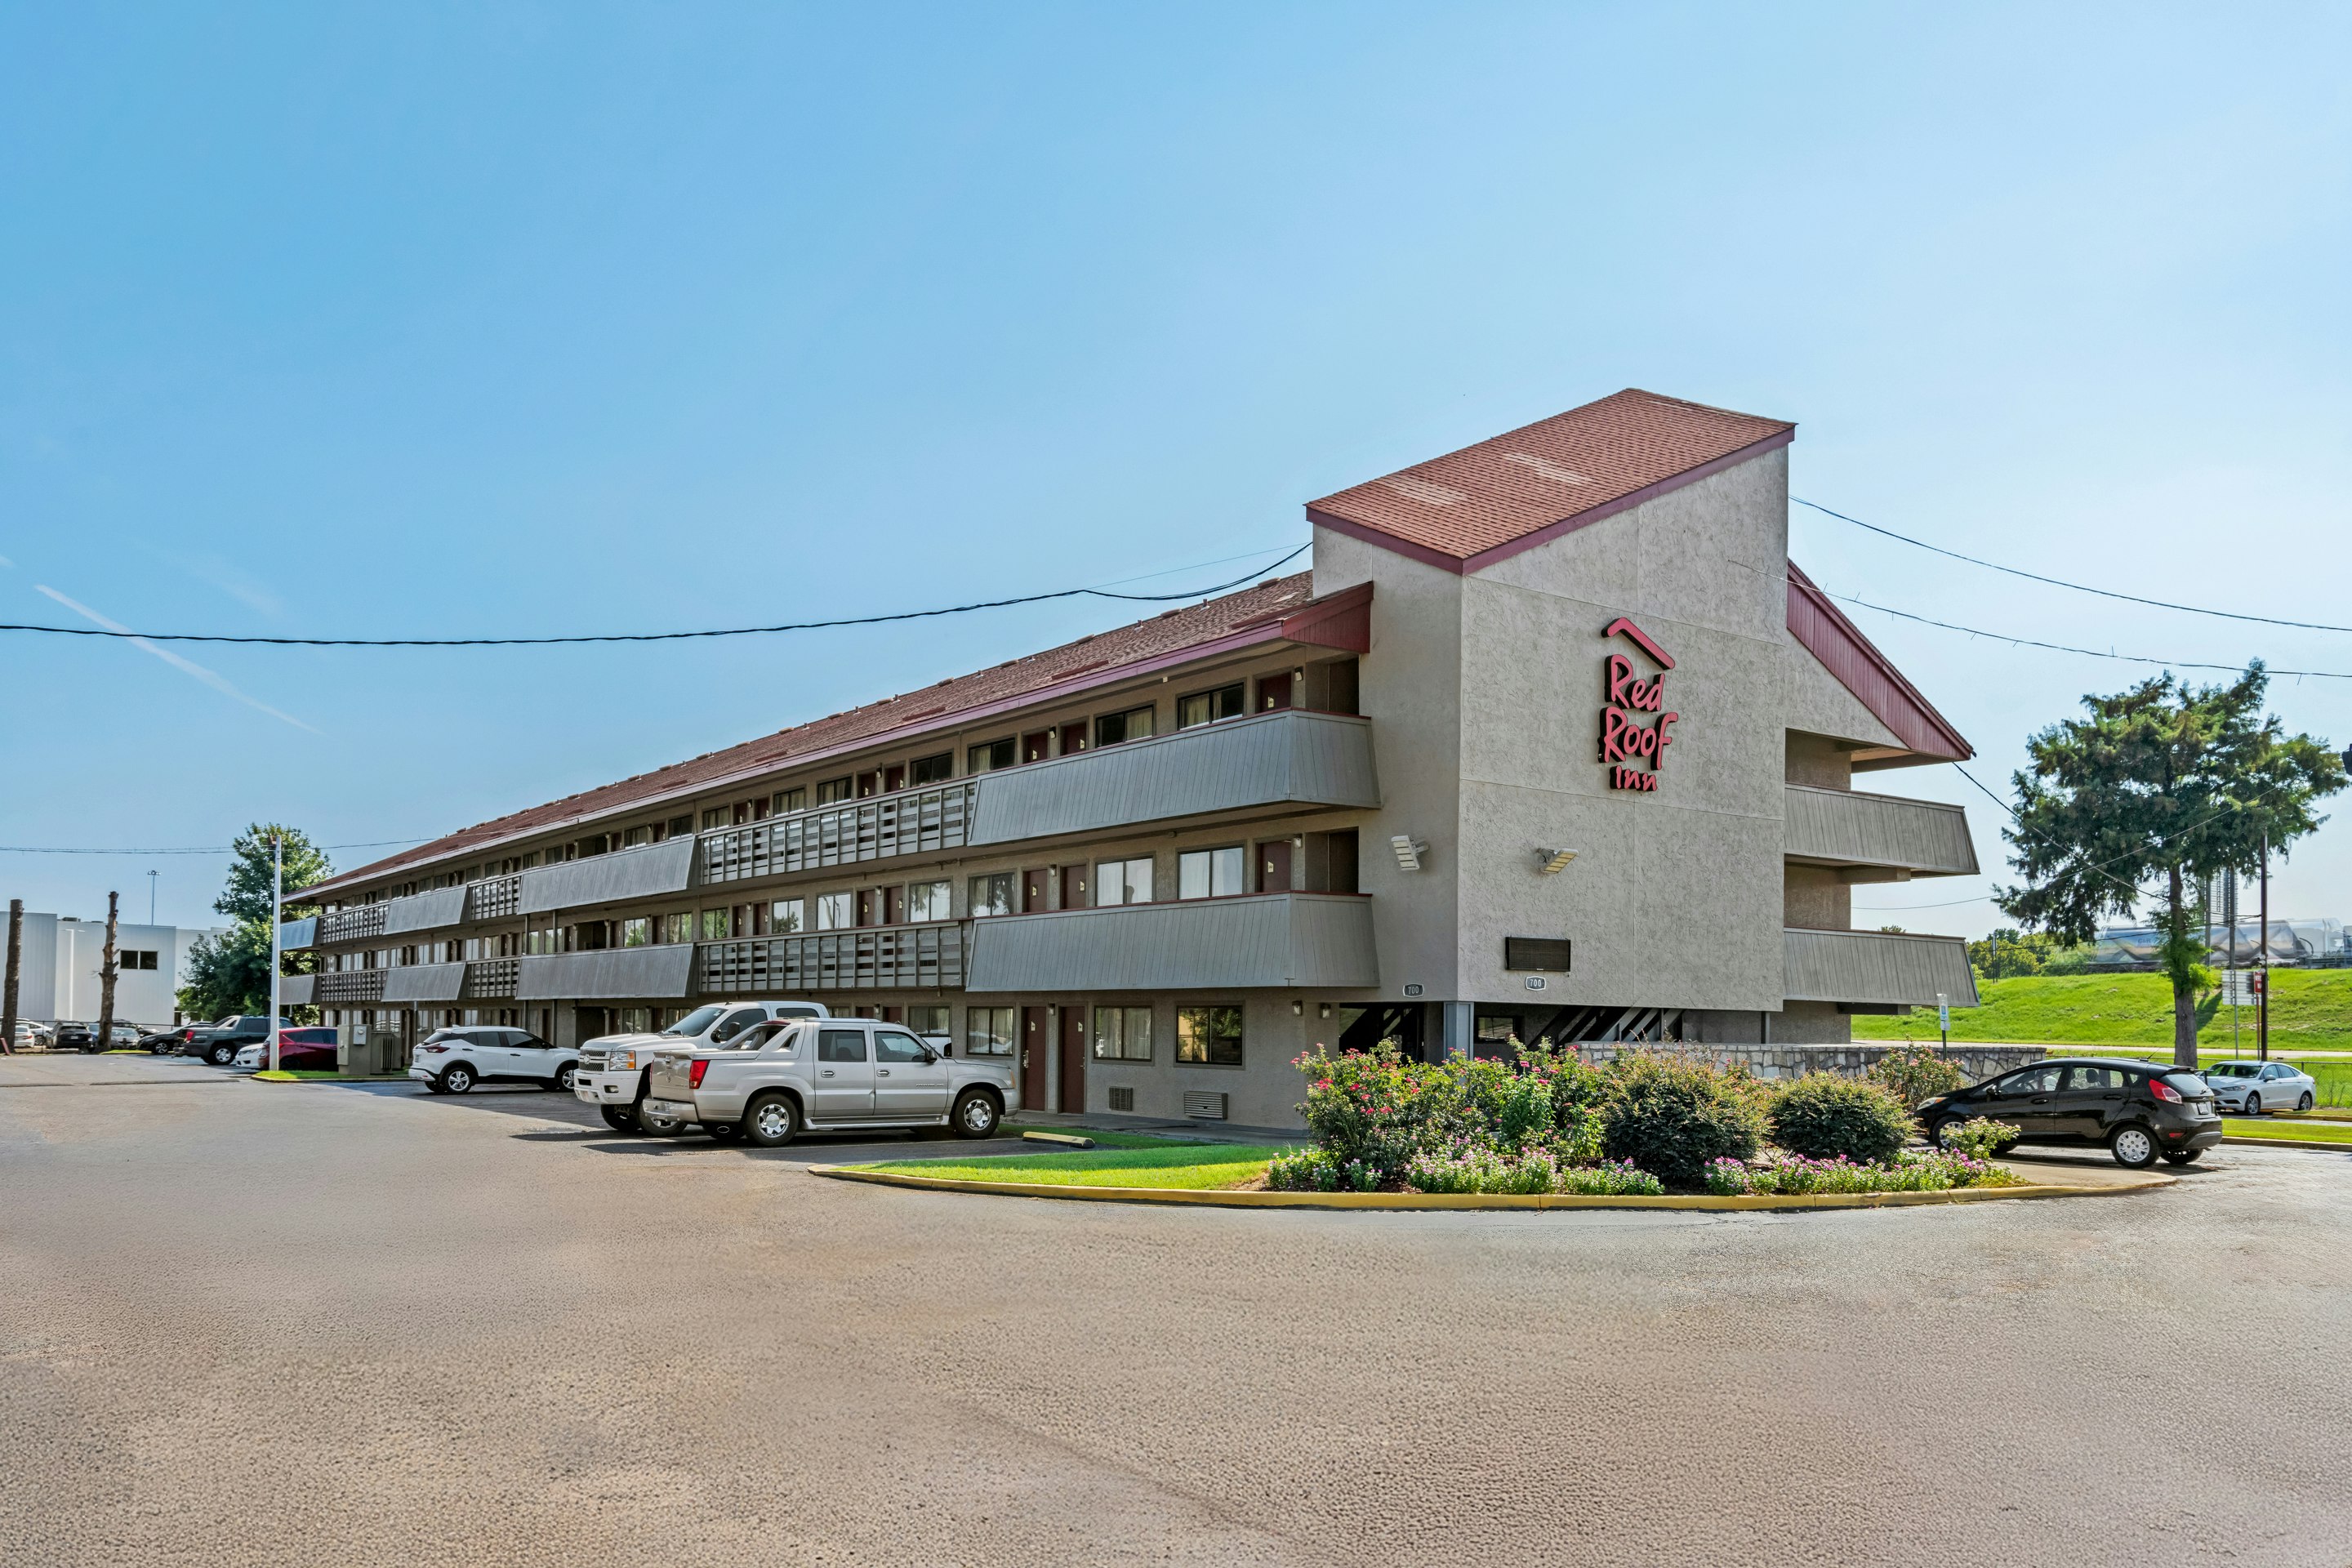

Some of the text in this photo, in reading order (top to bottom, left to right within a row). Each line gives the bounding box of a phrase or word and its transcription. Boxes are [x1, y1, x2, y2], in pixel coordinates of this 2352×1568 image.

[1606, 654, 1665, 712] Red
[1599, 706, 1678, 770] Roof
[1408, 986, 1419, 995] 700
